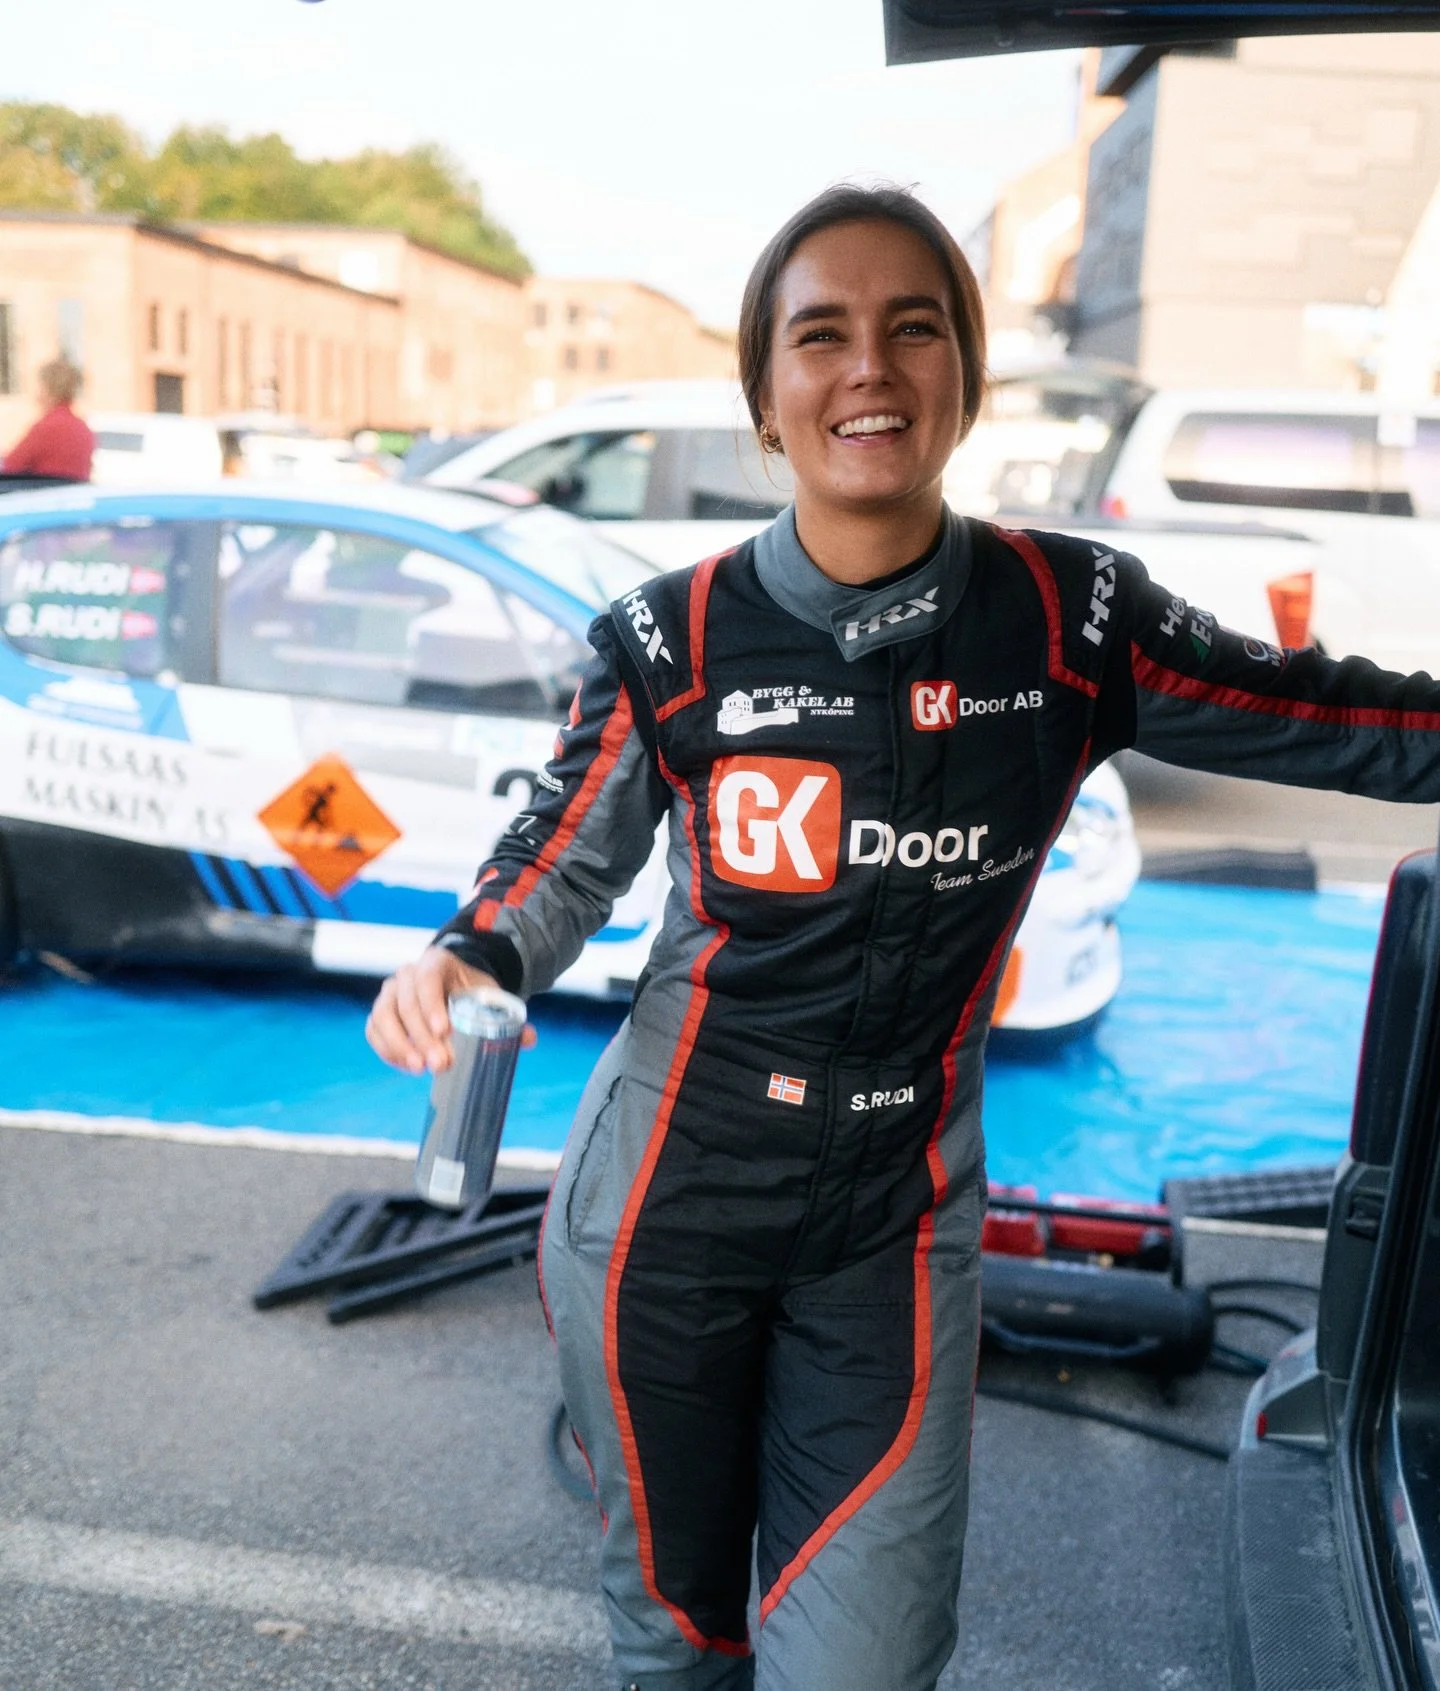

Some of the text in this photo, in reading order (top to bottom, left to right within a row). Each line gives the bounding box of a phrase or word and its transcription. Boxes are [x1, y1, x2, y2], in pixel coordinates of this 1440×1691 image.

[14, 560, 130, 596] H.RUDI
[1081, 546, 1117, 647] HRX
[5, 602, 121, 640] S.RUDI
[622, 589, 674, 665] HRX
[845, 586, 939, 641] HRX
[751, 685, 812, 699] BYGG &
[772, 696, 854, 709] KAKEL AB
[914, 685, 1044, 725] GK Door AB
[810, 708, 855, 716] NYKÖPING
[716, 770, 989, 881] GK Door
[930, 846, 1036, 892] Team Sweden
[850, 1086, 914, 1111] S.RUDI
